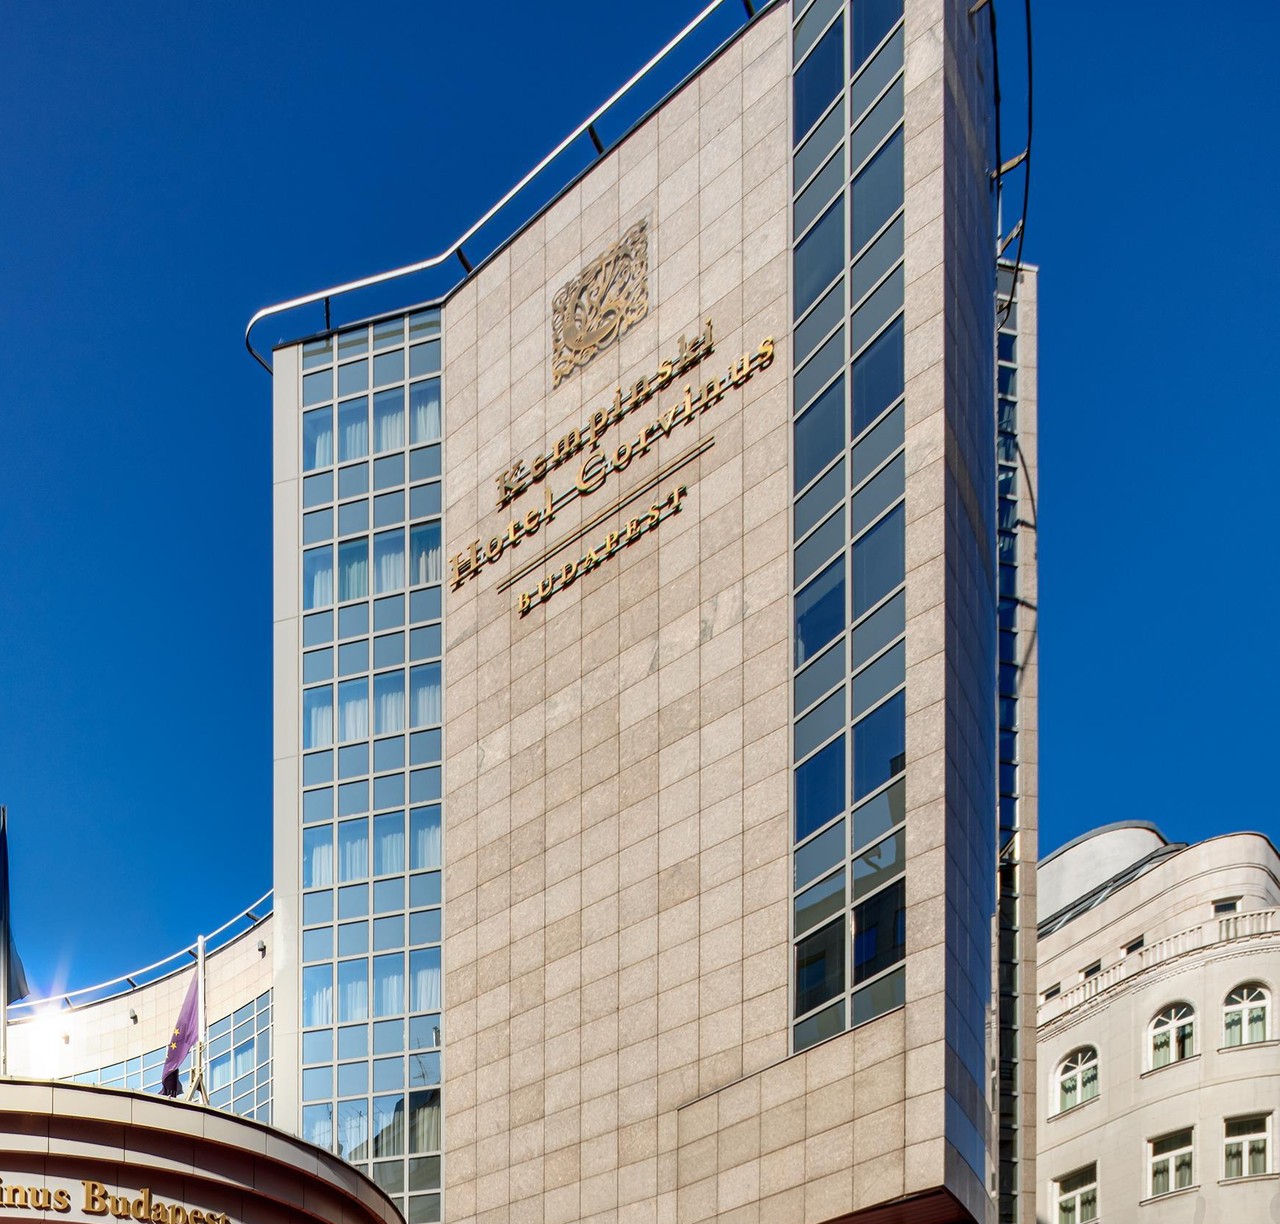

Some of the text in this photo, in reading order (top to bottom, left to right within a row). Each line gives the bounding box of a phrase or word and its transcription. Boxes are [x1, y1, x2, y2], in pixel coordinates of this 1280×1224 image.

[449, 336, 776, 592] Hotel Corvinus
[496, 318, 715, 511] Kempinski
[517, 483, 687, 619] BUDAPEST
